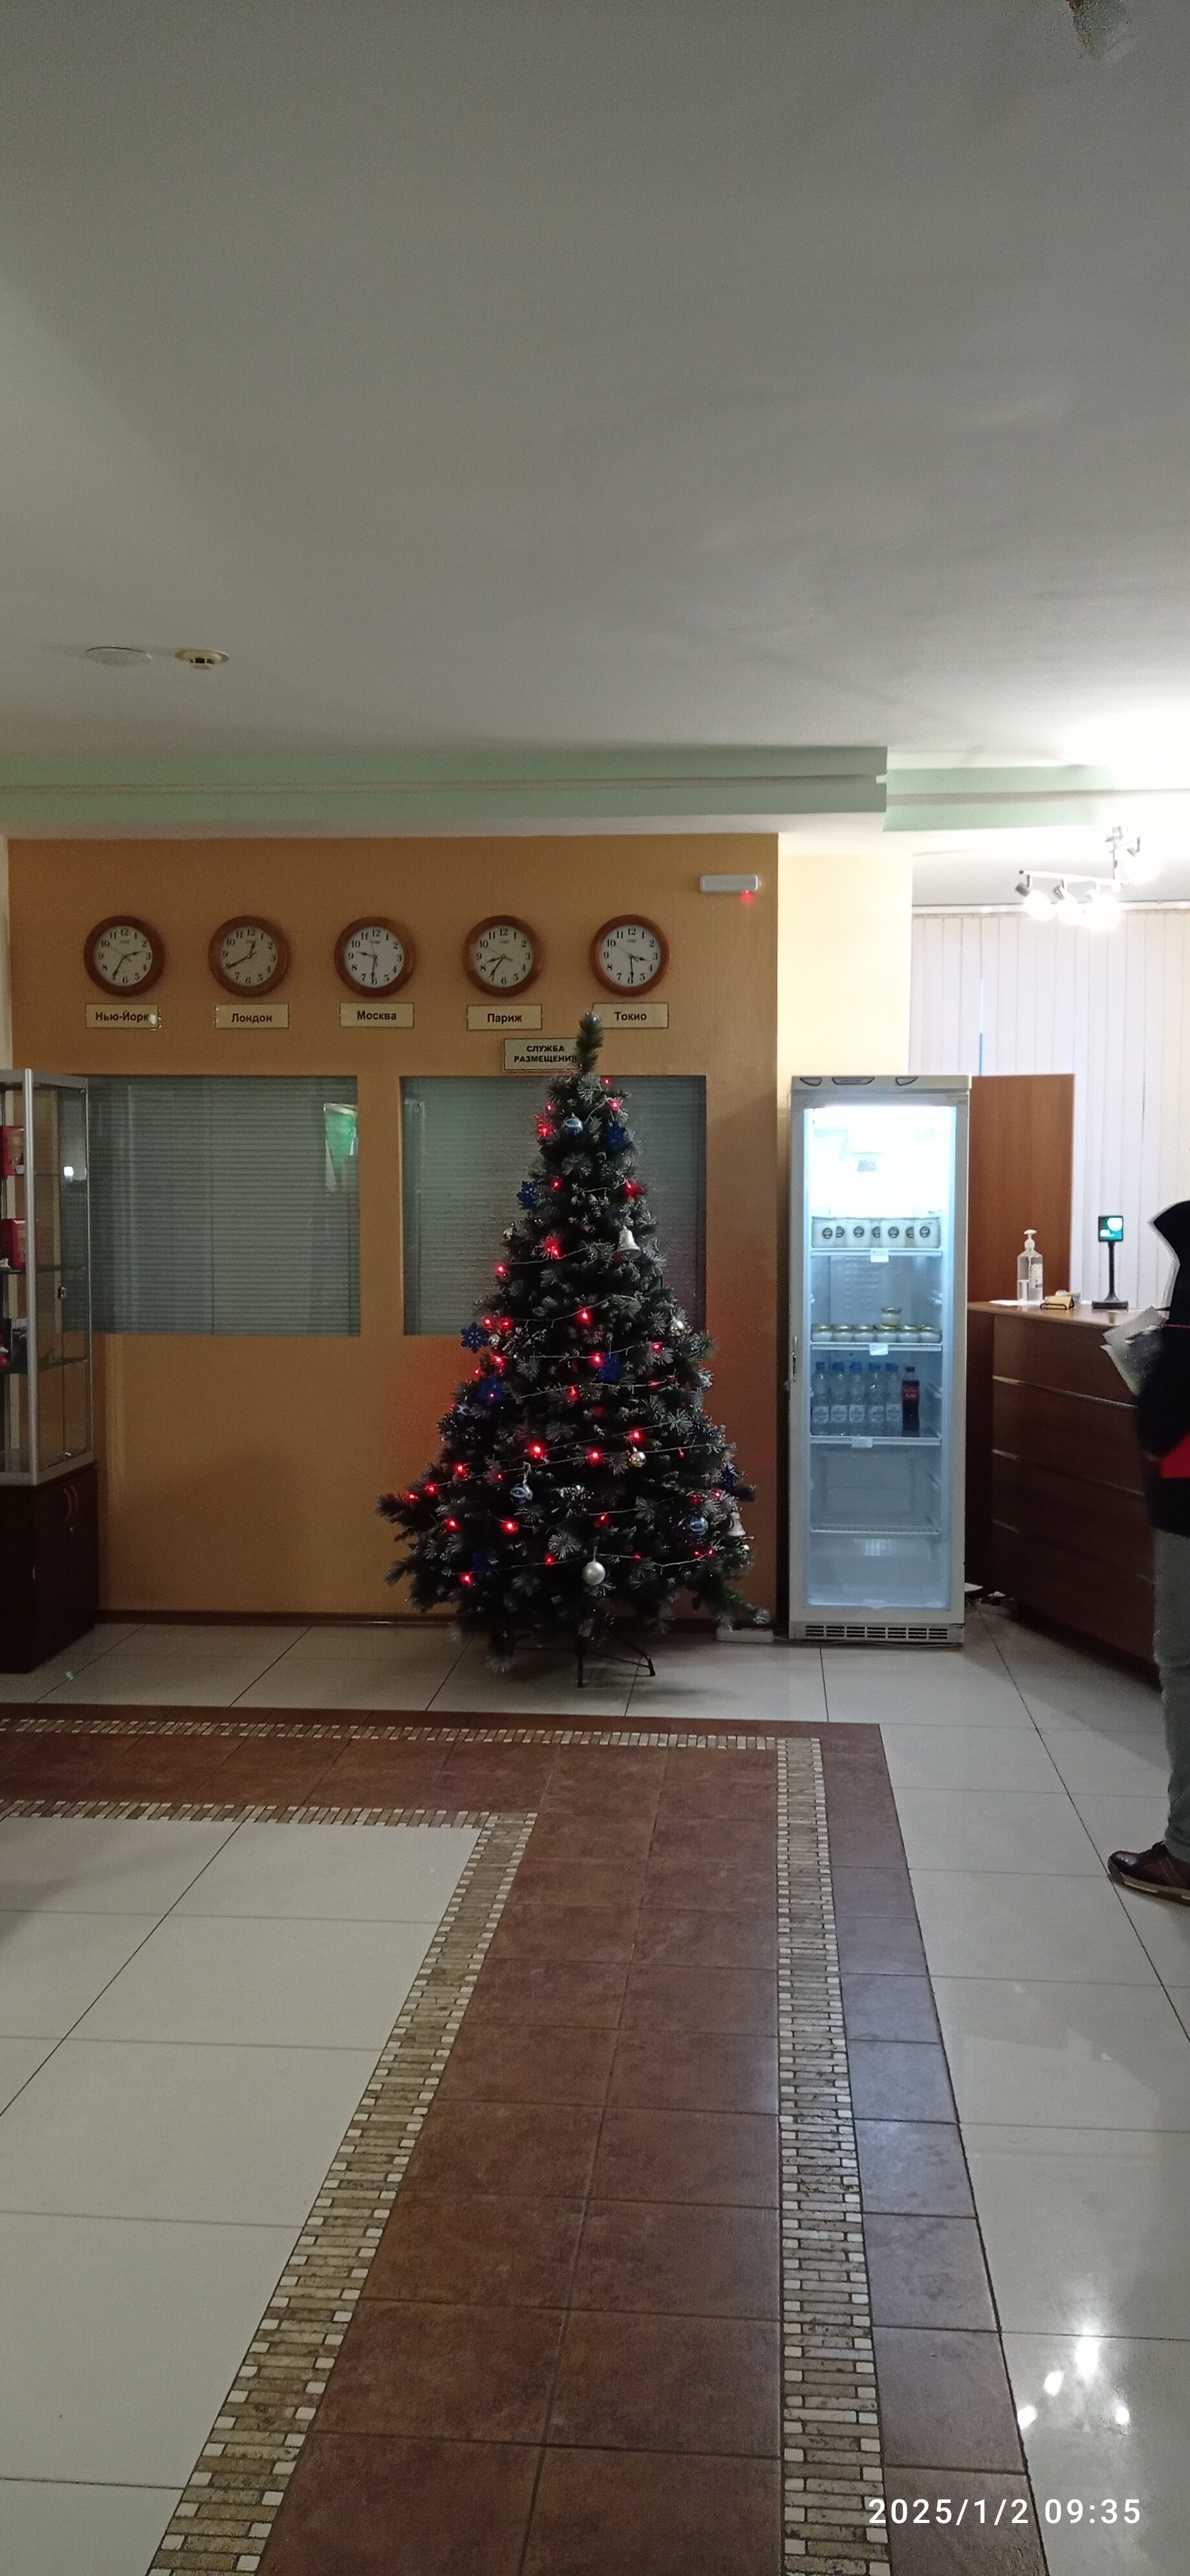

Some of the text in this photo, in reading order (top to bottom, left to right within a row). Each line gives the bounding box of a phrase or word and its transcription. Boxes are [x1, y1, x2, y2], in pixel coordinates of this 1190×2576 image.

[361, 932, 368, 940] 11
[488, 931, 495, 939] 11
[499, 928, 508, 936] 12
[101, 939, 110, 948] 10
[226, 938, 235, 947] 10
[268, 941, 273, 950] 2
[479, 939, 489, 948] 10
[607, 939, 616, 947] 10
[649, 939, 654, 948] 2
[235, 972, 240, 981] 7
[616, 972, 622, 981] 7
[95, 1010, 149, 1022] Нью-Йорк
[232, 1013, 272, 1023] Лондон
[357, 1011, 396, 1020] Москва
[487, 1013, 522, 1024] Париж
[614, 1011, 647, 1021] Токио
[514, 1055, 576, 1064] РАЗМЕЩЕНИЯ
